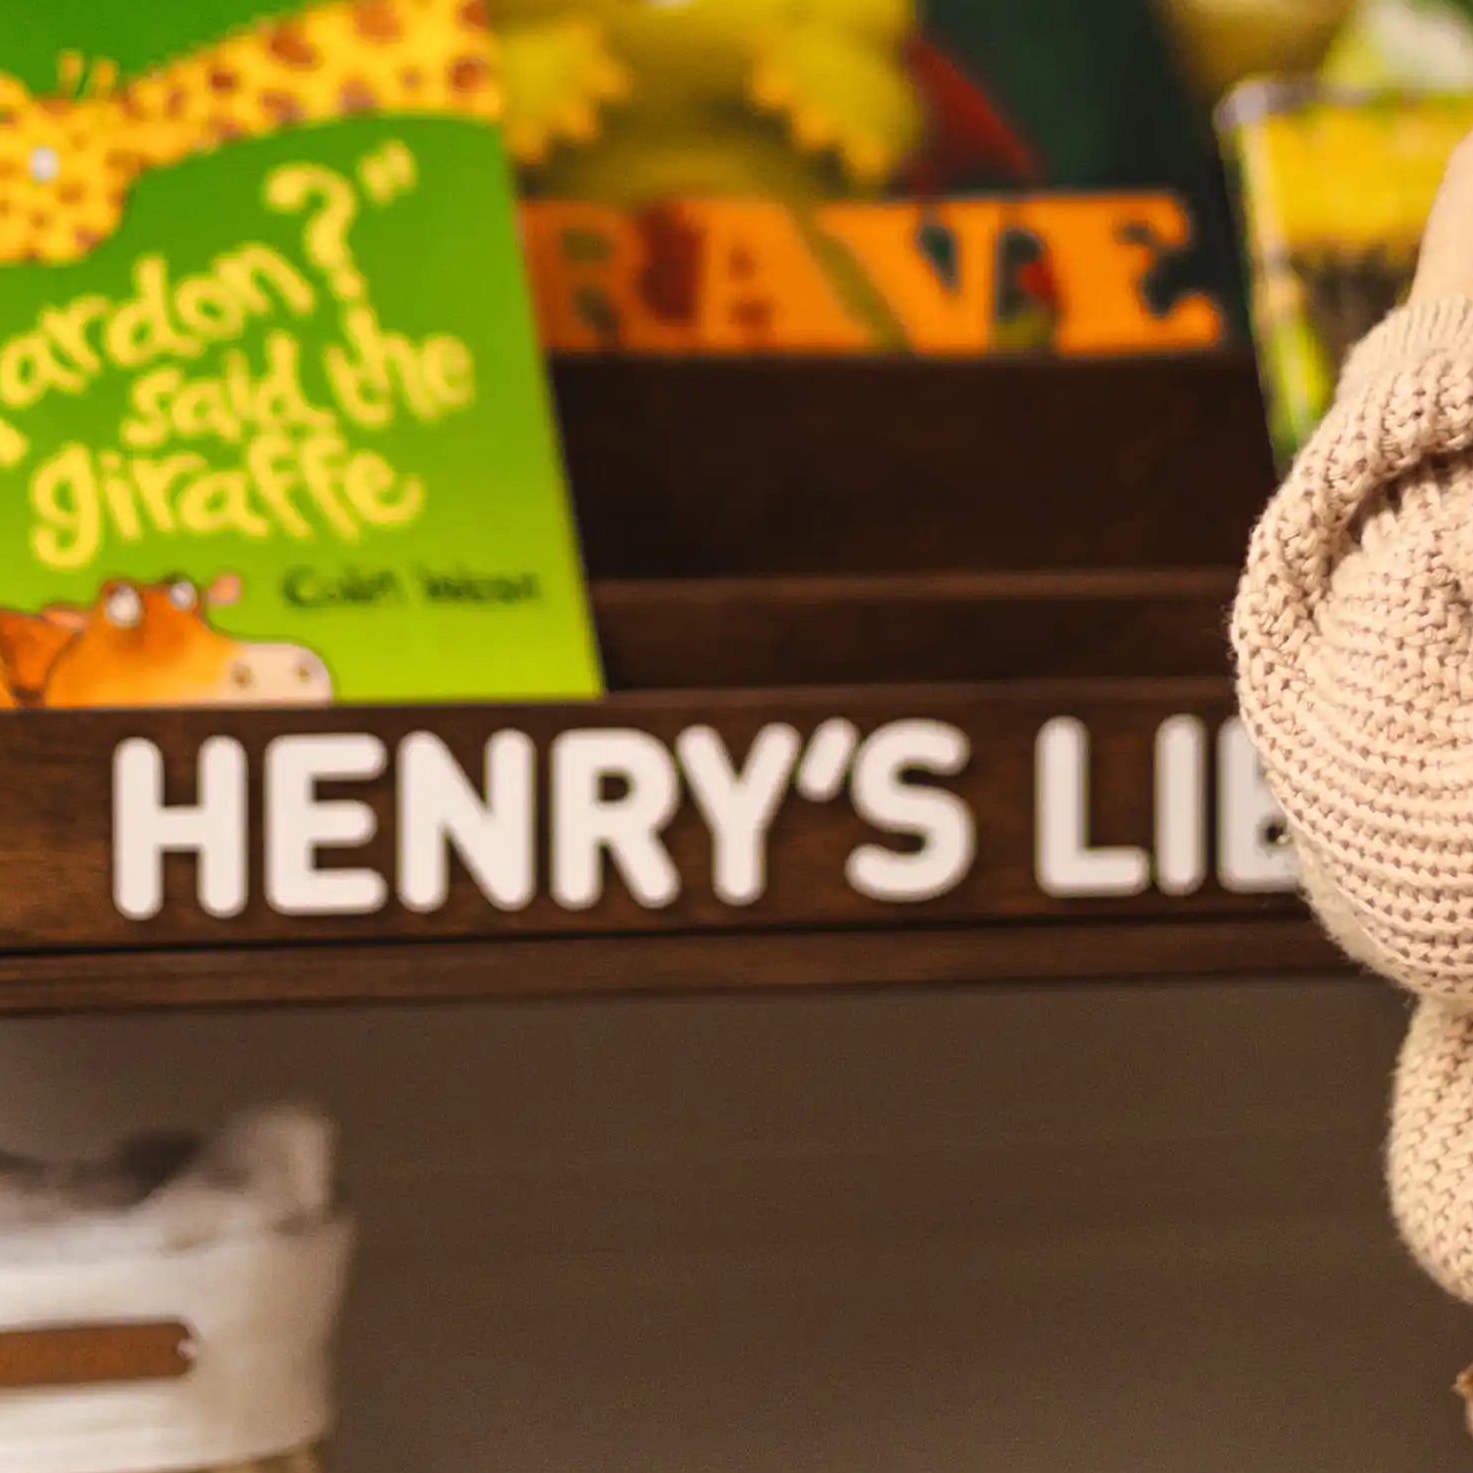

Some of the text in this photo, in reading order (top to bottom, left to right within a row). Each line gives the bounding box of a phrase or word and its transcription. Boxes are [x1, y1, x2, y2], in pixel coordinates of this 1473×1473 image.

[121, 304, 476, 451] said the
[30, 421, 424, 569] giraffe
[111, 717, 975, 920] HENRY'S
